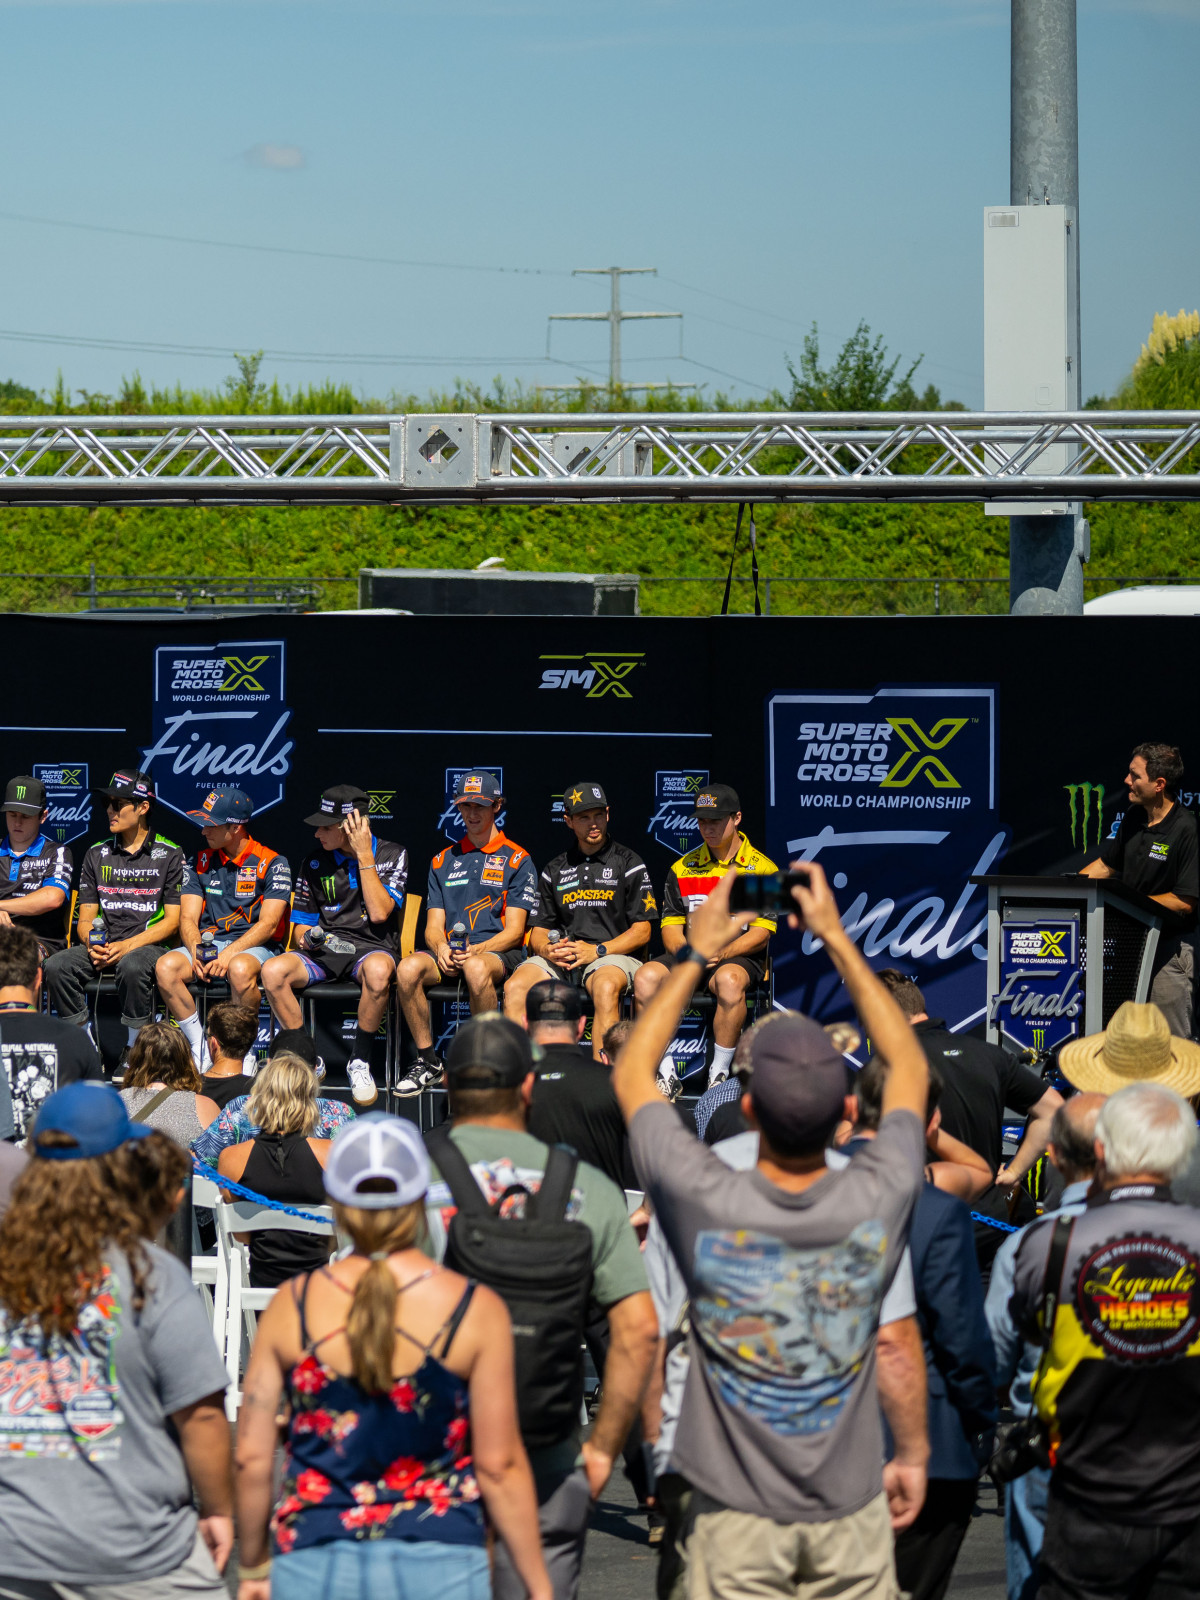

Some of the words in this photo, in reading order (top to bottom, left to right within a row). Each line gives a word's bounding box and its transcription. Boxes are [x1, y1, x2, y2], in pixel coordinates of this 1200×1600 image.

[171, 659, 226, 669] SUPER
[175, 669, 223, 679] MOTO
[538, 662, 638, 698] SMX
[171, 679, 224, 689] CROSS
[204, 694, 271, 702] CHAMPIONSHIP
[797, 722, 894, 741] SUPER
[137, 709, 294, 776] Finals
[803, 743, 888, 761] MOTO
[798, 763, 890, 782] CROSS
[46, 792, 92, 822] inals
[800, 794, 852, 808] WORLD
[856, 795, 971, 809] CHAMPIONSHIP
[647, 800, 700, 833] Fina
[113, 868, 160, 877] MONSTER
[100, 898, 157, 912] Kawasaki
[990, 968, 1082, 1020] Finals
[1100, 1300, 1190, 1322] HEROES
